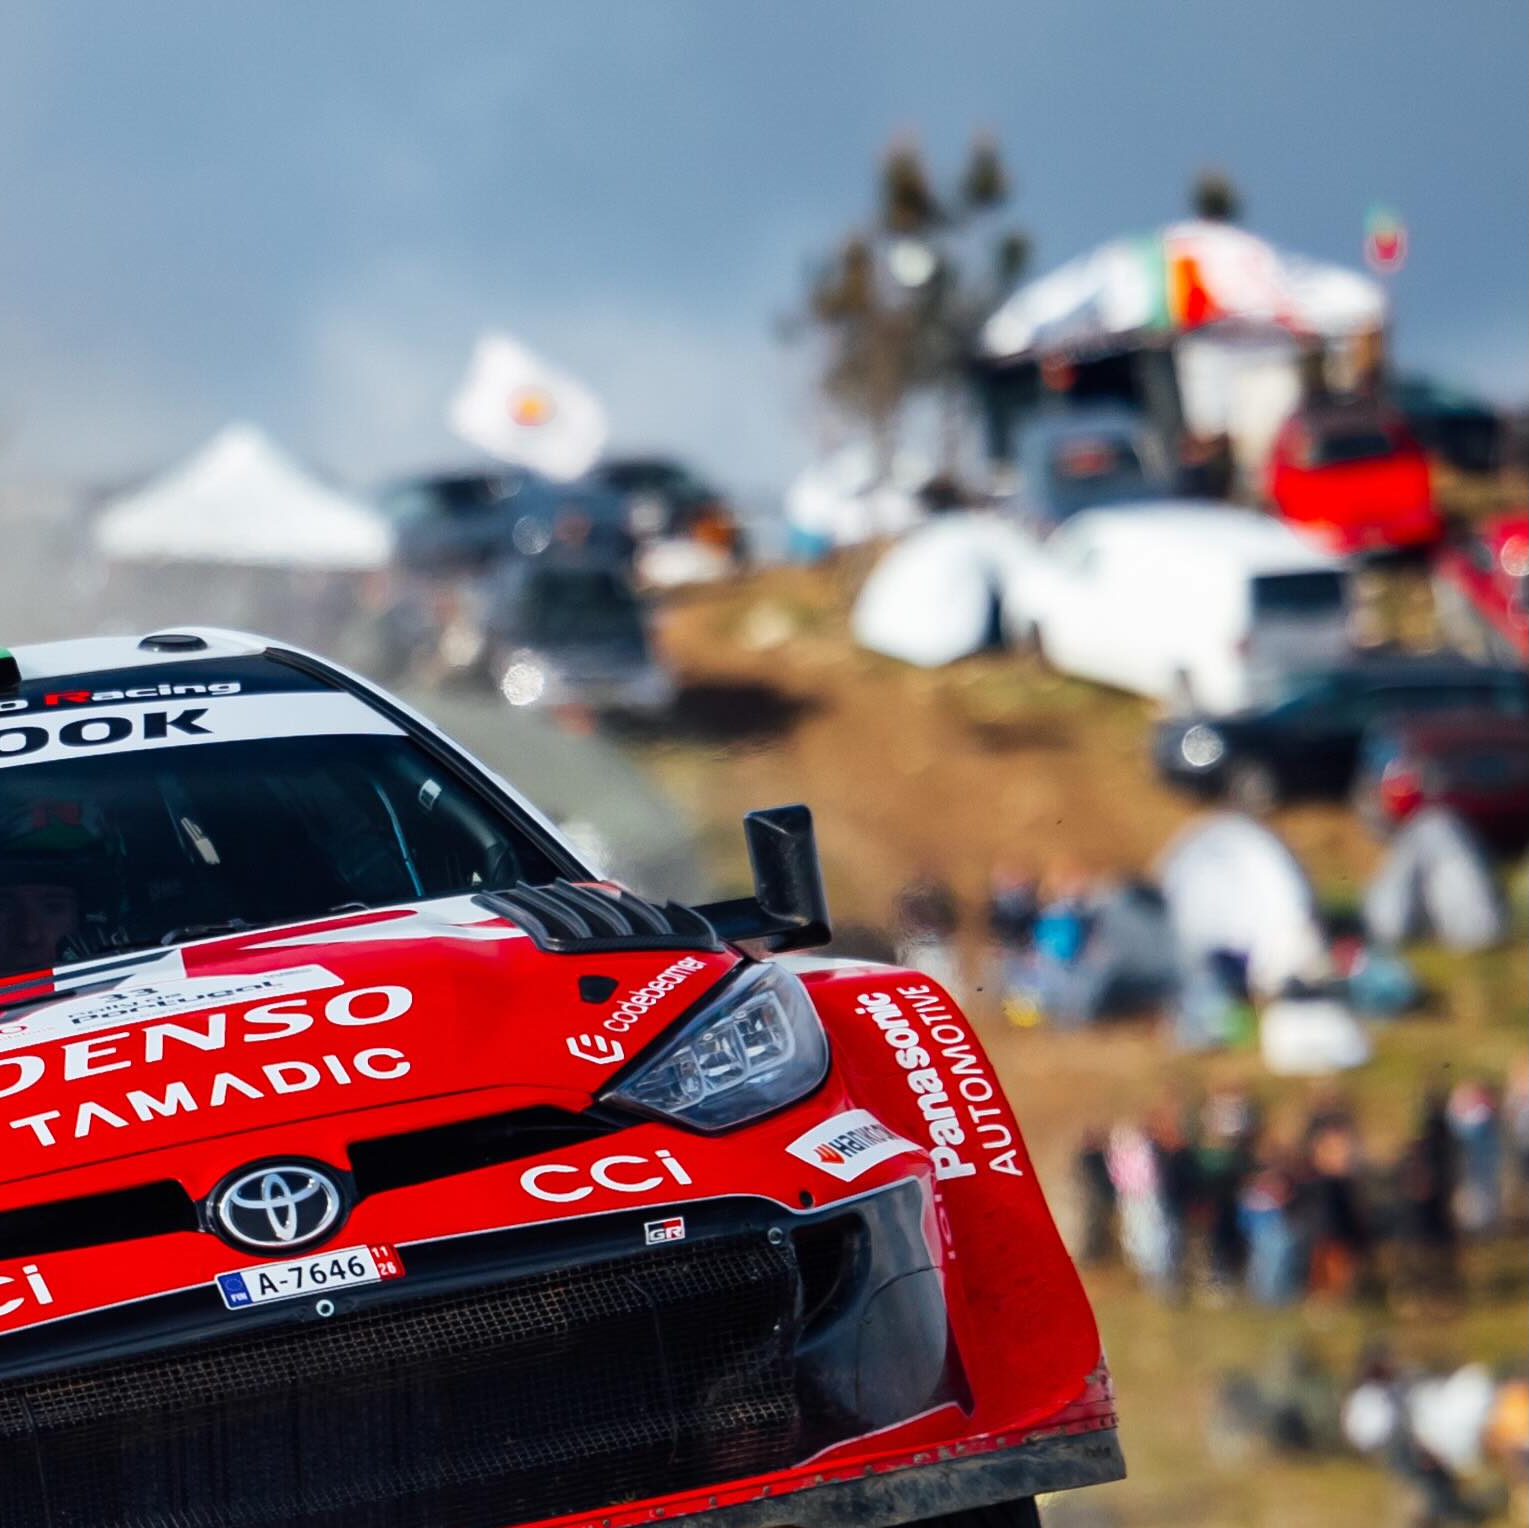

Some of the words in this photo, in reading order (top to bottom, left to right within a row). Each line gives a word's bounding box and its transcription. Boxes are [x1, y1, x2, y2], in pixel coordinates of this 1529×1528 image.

[44, 681, 242, 706] Racing
[603, 955, 707, 1034] codebeamer
[10, 1047, 412, 1147] TAMADIC
[855, 990, 976, 1181] Panasonic
[898, 983, 1023, 1178] AUTOMOTIVE
[648, 1220, 684, 1243] GR
[258, 1255, 366, 1296] A-7646
